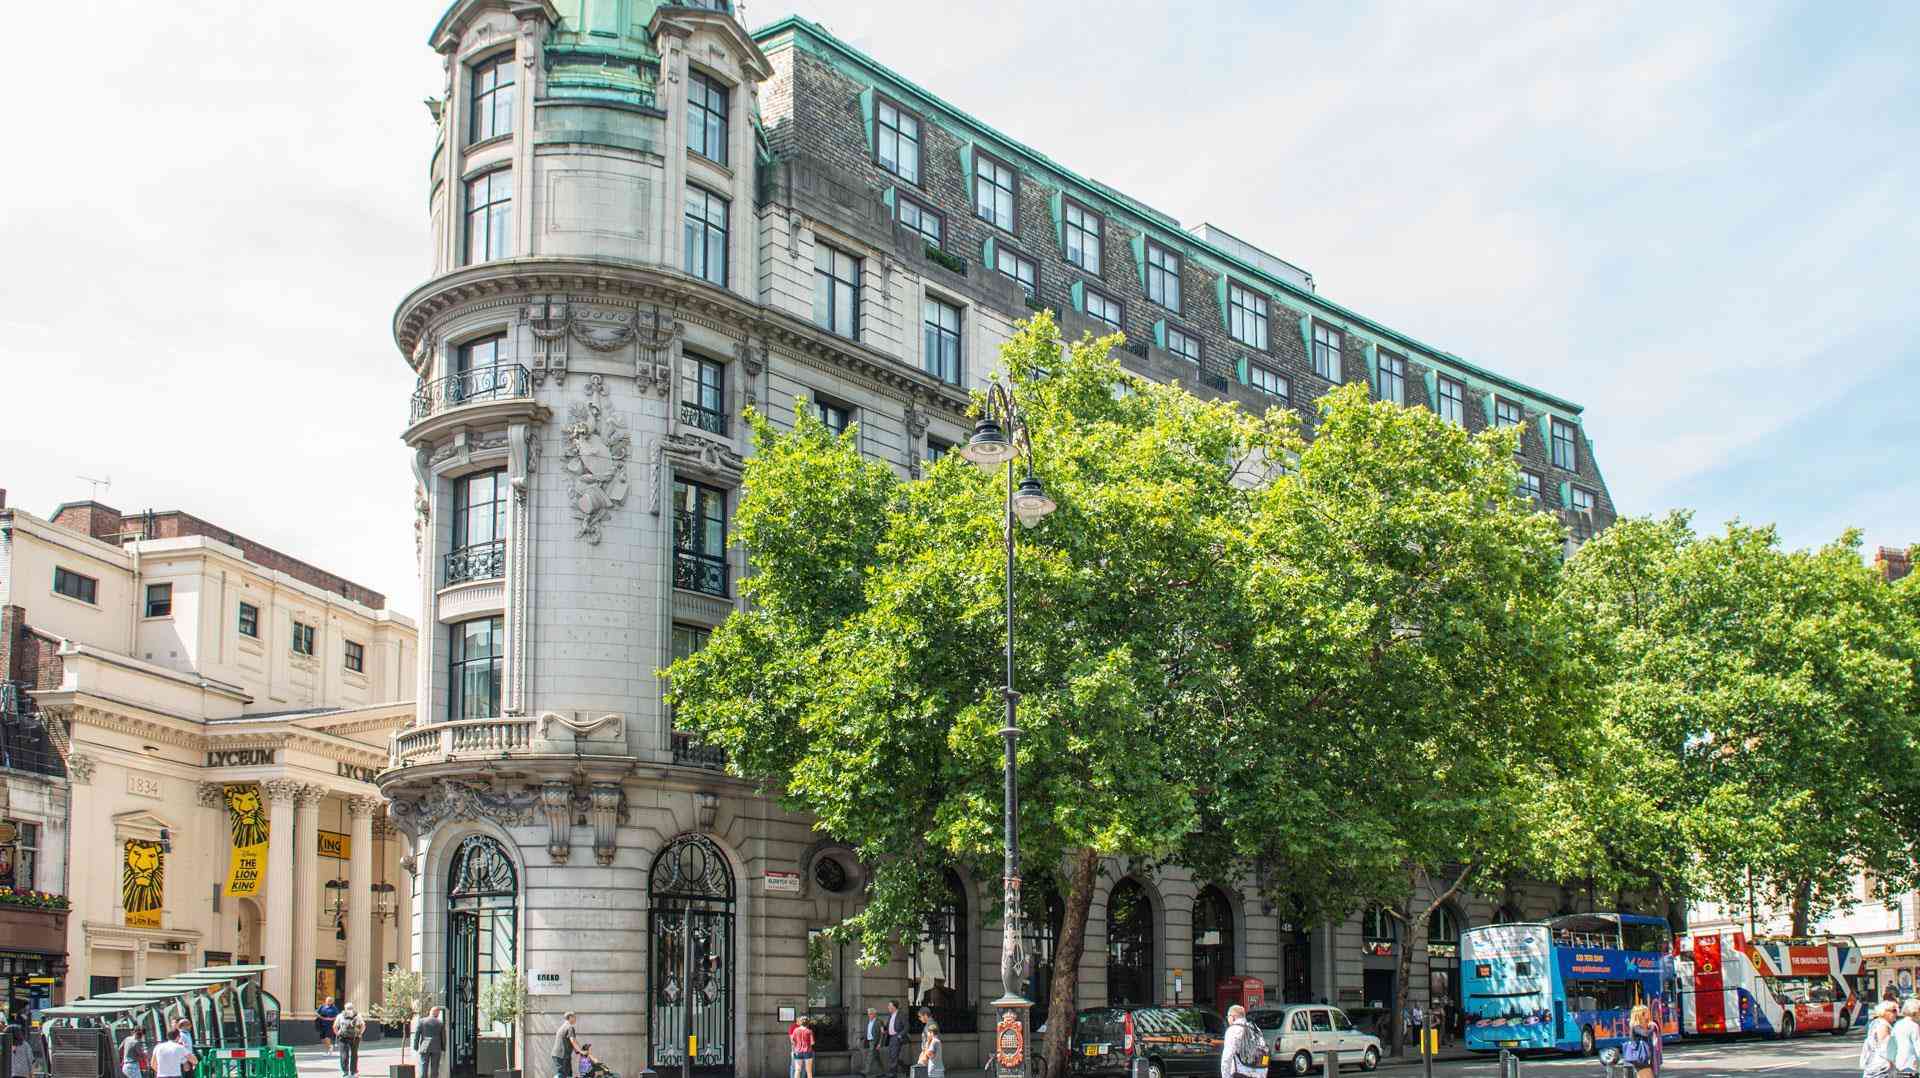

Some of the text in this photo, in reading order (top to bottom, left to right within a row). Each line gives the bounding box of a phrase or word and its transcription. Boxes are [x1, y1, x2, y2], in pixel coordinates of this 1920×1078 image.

[207, 749, 275, 767] LYCEUM
[131, 776, 158, 796] 1834
[240, 859, 256, 867] THE
[235, 870, 258, 879] LION
[231, 881, 256, 890] KING
